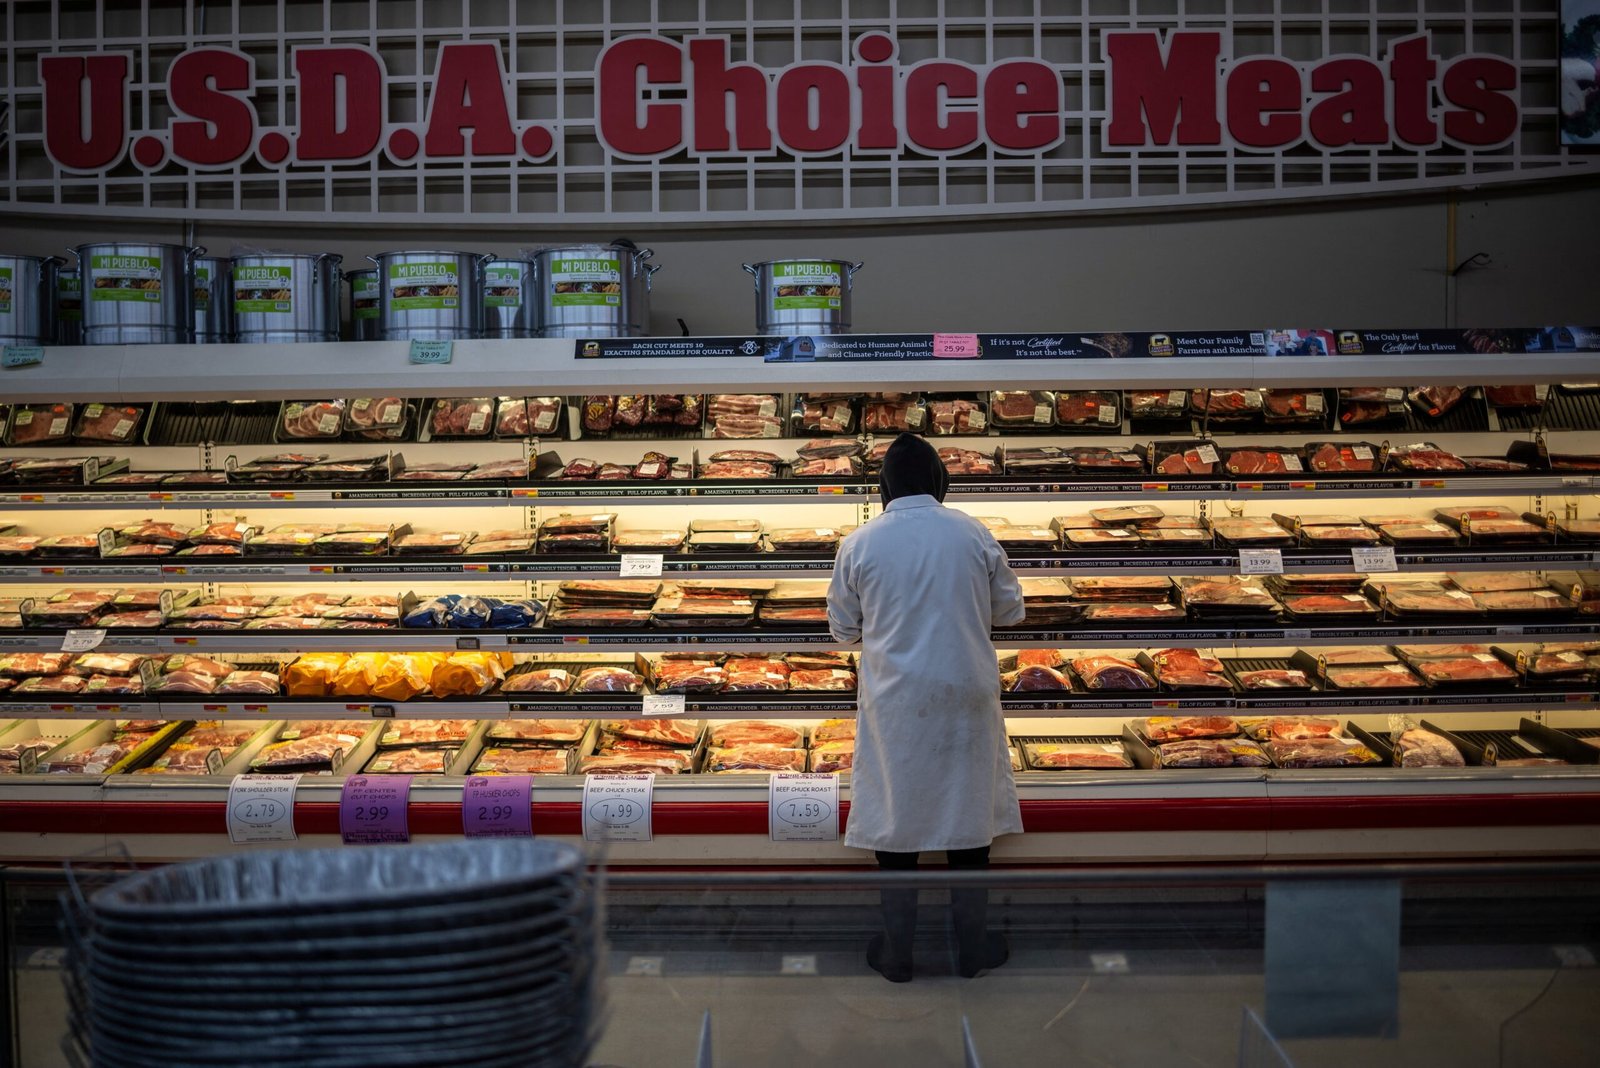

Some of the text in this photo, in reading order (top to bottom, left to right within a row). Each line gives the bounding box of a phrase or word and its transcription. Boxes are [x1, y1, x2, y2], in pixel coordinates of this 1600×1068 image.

[40, 31, 1519, 170] U.S.D.A. Choice Meats
[101, 257, 150, 269] MI PUEBLO
[561, 261, 610, 272] MI PUEBLO
[238, 268, 280, 280] MI PUEBLO
[398, 265, 446, 277] MI PUEBLO
[784, 264, 832, 276] MI PUEBLO
[1028, 337, 1063, 349] Certified
[1216, 337, 1244, 346] Family
[1227, 346, 1267, 354] Ranchers
[1381, 342, 1417, 354] Certified
[843, 351, 905, 359] Climate-Friendly
[246, 804, 276, 818] 2.79
[355, 806, 389, 821] 2.99
[478, 805, 513, 821] 2.99
[602, 804, 633, 818] 7.99
[789, 803, 820, 817] 7.59
